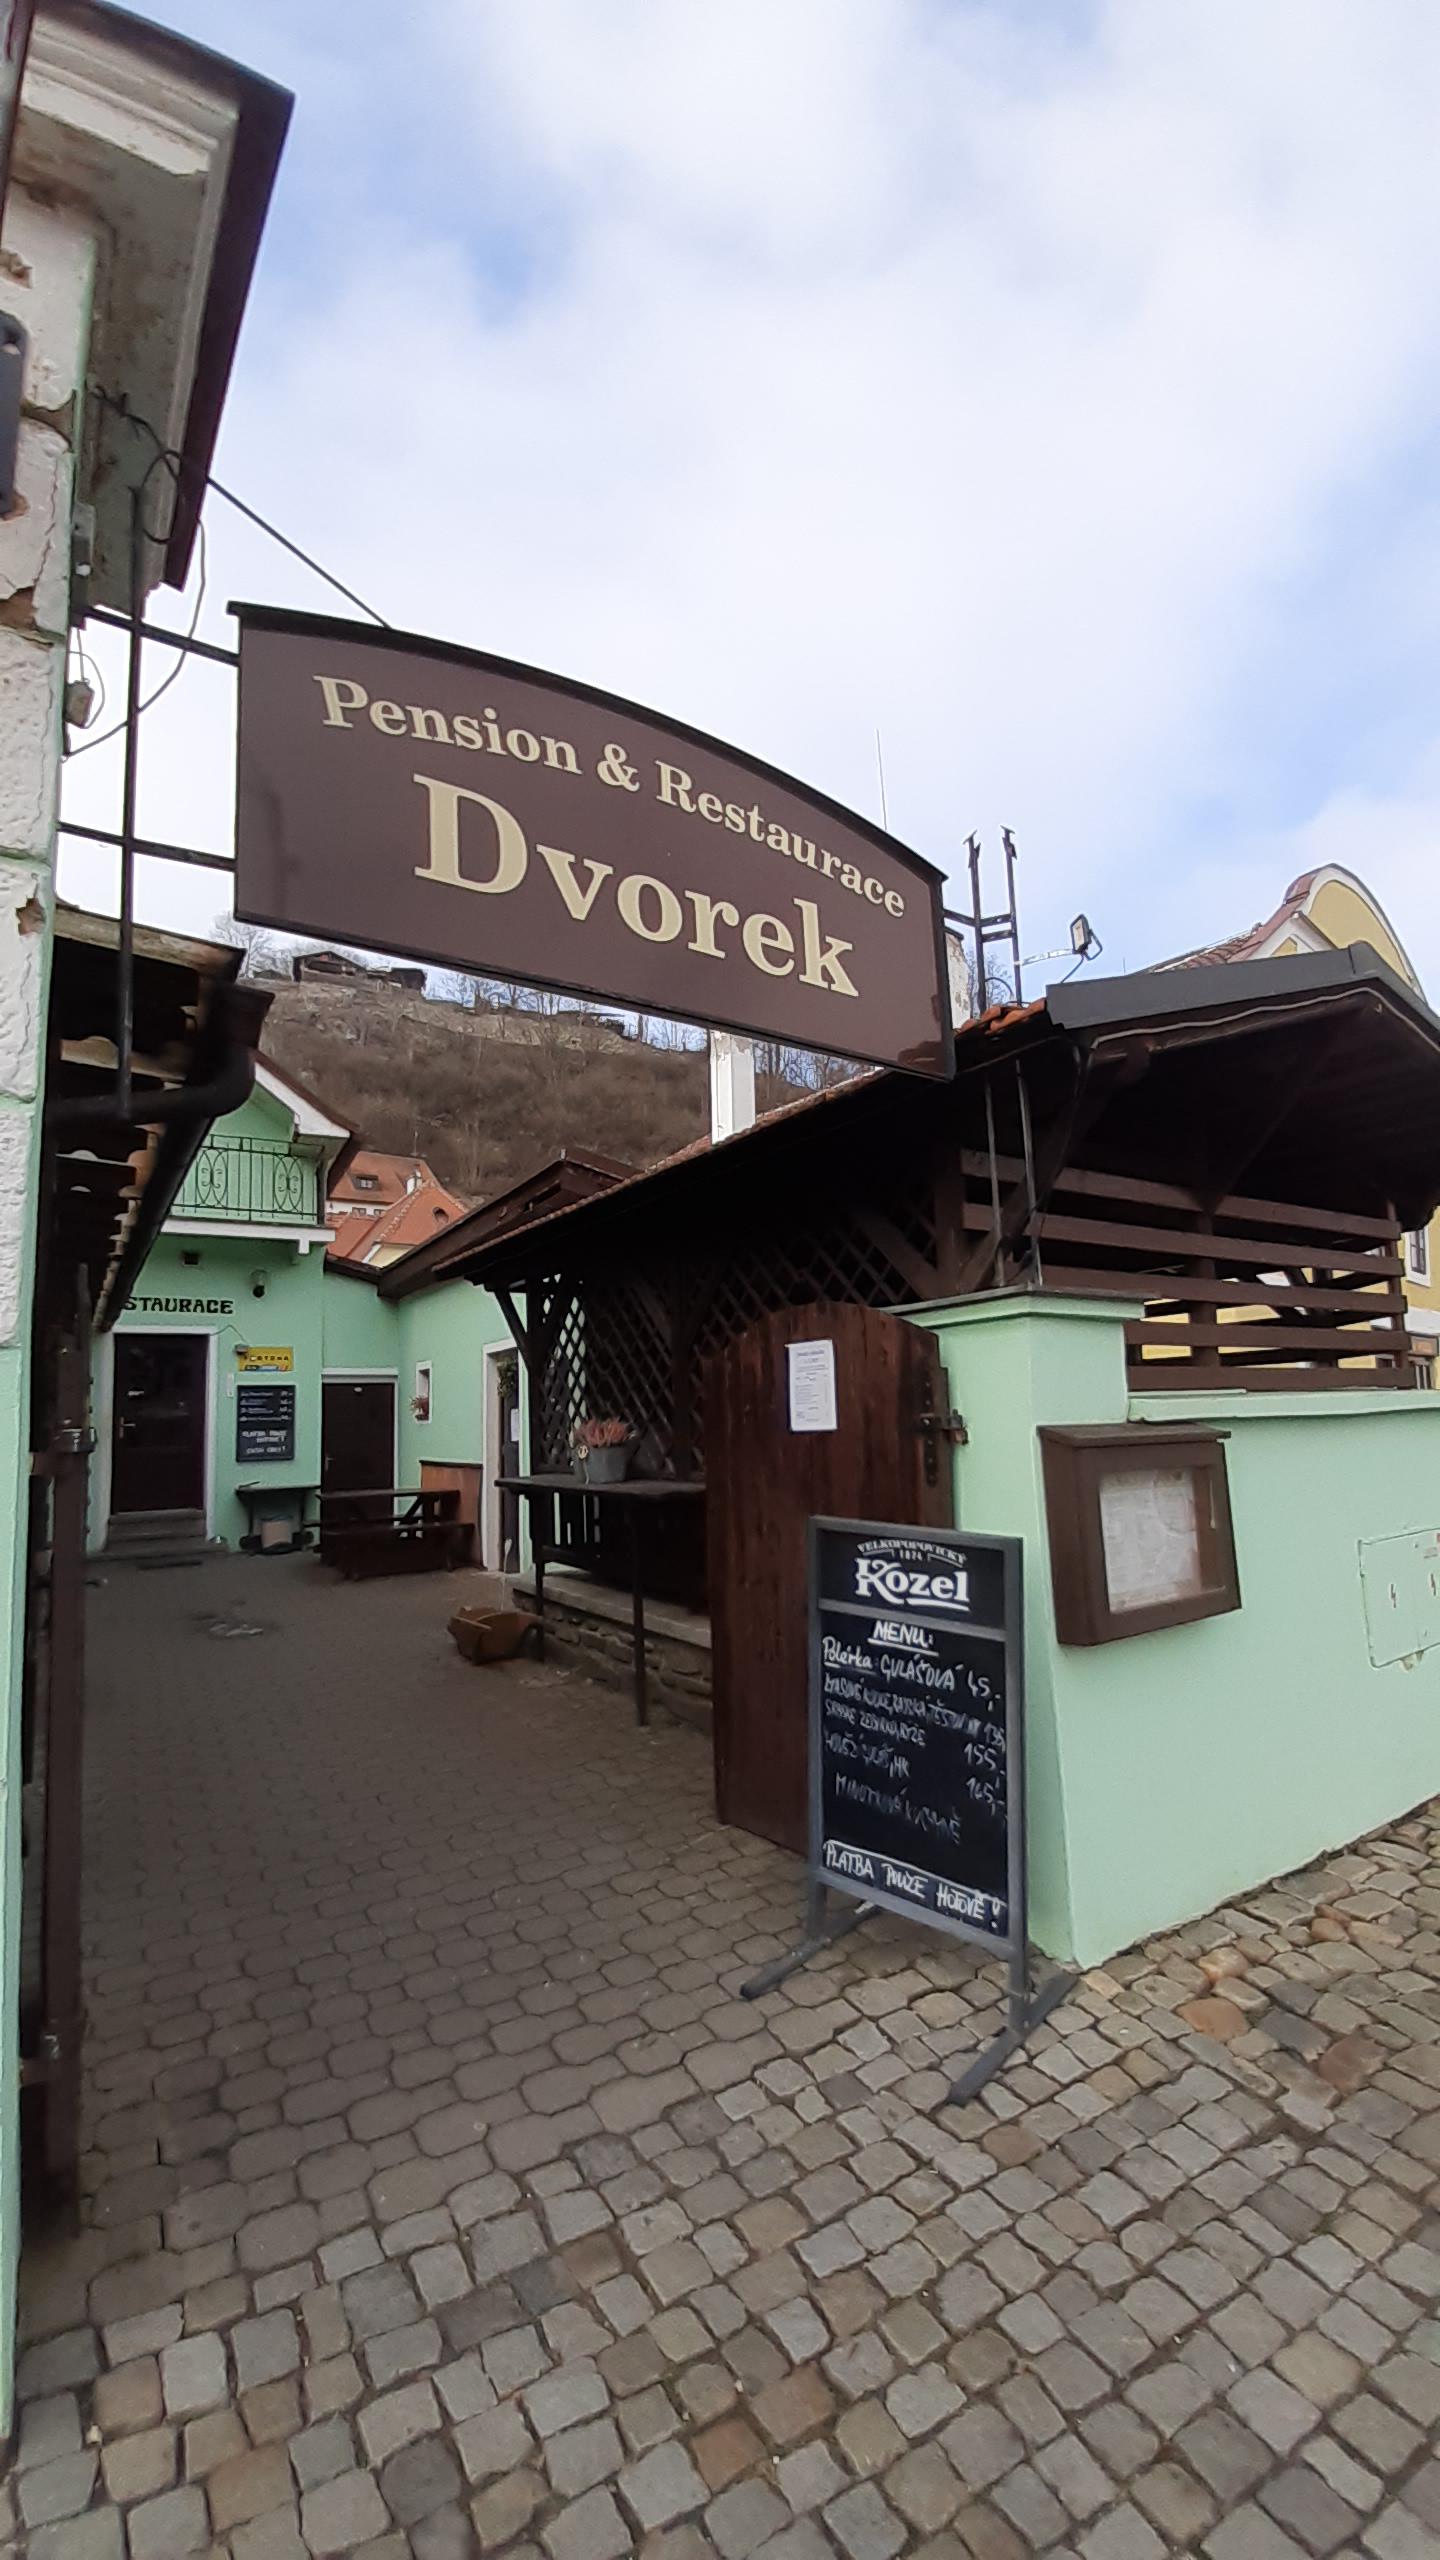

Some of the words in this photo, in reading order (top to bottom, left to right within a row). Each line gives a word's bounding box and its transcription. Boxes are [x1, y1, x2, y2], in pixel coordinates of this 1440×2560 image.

[313, 675, 582, 775] Pension
[597, 743, 640, 792] &
[655, 760, 905, 917] Restaurace
[413, 773, 859, 997] Dvorek
[855, 1557, 970, 1605] Kozel
[823, 1841, 875, 1879] PLATBA
